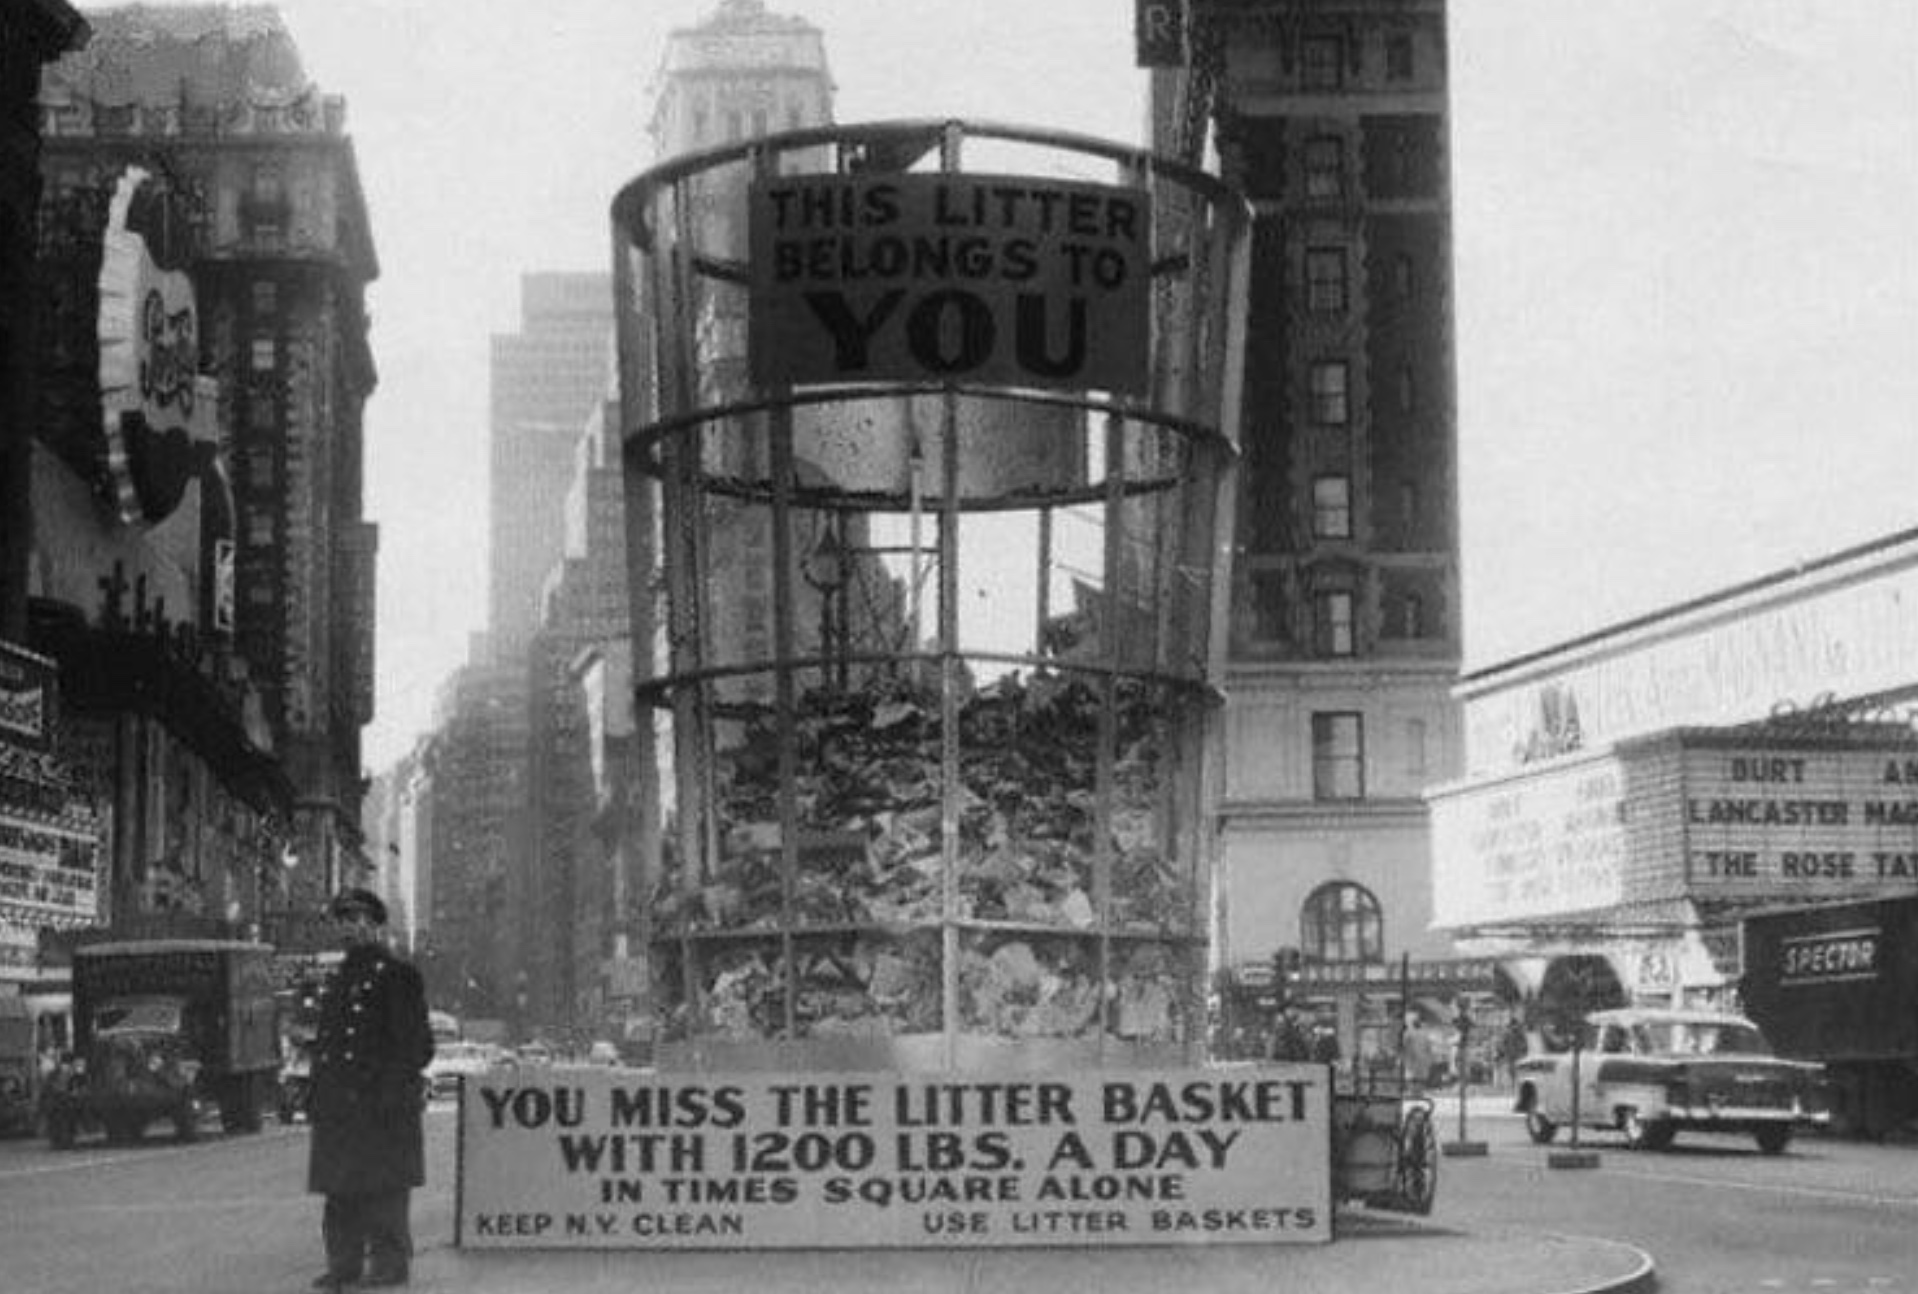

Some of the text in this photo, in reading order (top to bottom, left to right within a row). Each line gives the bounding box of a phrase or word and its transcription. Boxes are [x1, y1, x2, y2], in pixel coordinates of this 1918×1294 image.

[769, 185, 1137, 238] THIS LITTER
[774, 236, 1127, 289] BELONGS TO
[805, 288, 1087, 379] YOU
[1690, 800, 1848, 825] LANCASTER
[1706, 853, 1757, 877] THE
[1782, 853, 1854, 877] ROSE
[1782, 941, 1875, 975] SPECTOR
[481, 1080, 1315, 1129] YOU MISS THE LITTER BASKET
[559, 1129, 1242, 1173] WITH 1200 LBS. A DAY
[602, 1174, 1186, 1207] IN TIMES SQUARE ALONE
[477, 1213, 552, 1236] KEEP
[632, 1212, 744, 1236] CLEAN
[924, 1207, 1316, 1234] USE LITTER BASKETS
